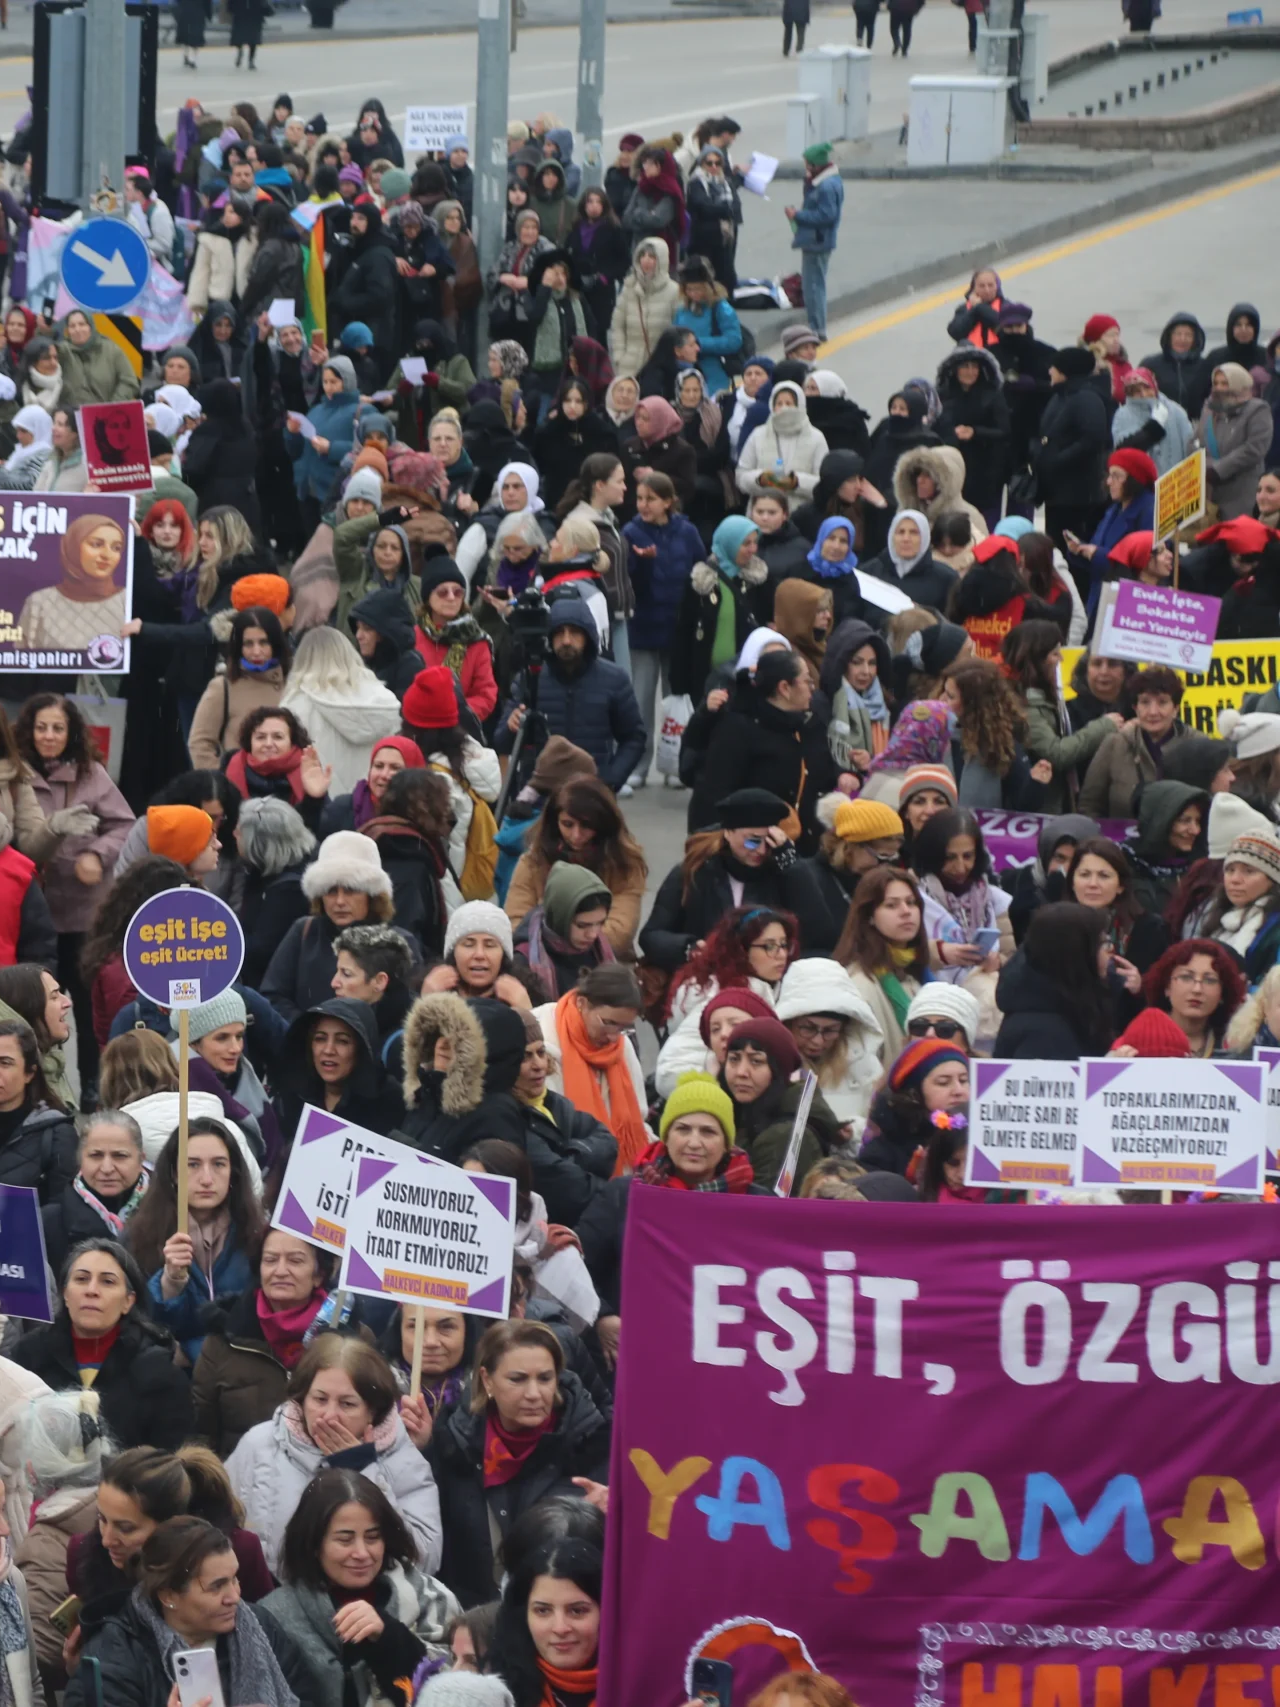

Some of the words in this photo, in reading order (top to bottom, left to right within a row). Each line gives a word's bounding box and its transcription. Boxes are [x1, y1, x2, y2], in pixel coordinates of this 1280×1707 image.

[11, 500, 68, 540] İÇİN
[1132, 586, 1169, 606] Evde,
[1119, 615, 1146, 631] Her
[1136, 603, 1196, 625] Sokakta
[139, 917, 186, 945] eşit
[190, 916, 227, 943] işe
[140, 947, 173, 967] eşit
[175, 944, 228, 963] ücret!
[1005, 1078, 1020, 1097] BU
[1023, 1076, 1075, 1099] DÜNYAYA
[980, 1102, 1030, 1124] ELİMİZDE
[1035, 1108, 1062, 1125] SARI
[1065, 1107, 1078, 1126] BE
[1103, 1091, 1241, 1114] TOPRAKLARIMIZDAN,
[1111, 1112, 1230, 1136] AĞAÇLARIMIZDAN
[983, 1125, 1027, 1149] ÖLMEYE
[1030, 1130, 1077, 1151] GELMED
[1111, 1134, 1228, 1159] VAZGEÇMİYORUZ!
[315, 1182, 350, 1219] İSTİ
[383, 1179, 479, 1219] SUSMUYORUZ,
[314, 1221, 347, 1248] HALKEV
[375, 1207, 482, 1249] KORKMUYORUZ,
[365, 1230, 401, 1261] İTAAT
[404, 1242, 489, 1277] ETMİYORUZ!
[423, 1279, 468, 1302] KADINLAR
[691, 1250, 956, 1407] EŞİT,
[999, 1259, 1280, 1386] ÖZGÜ
[628, 1447, 1280, 1596] YAŞAMA
